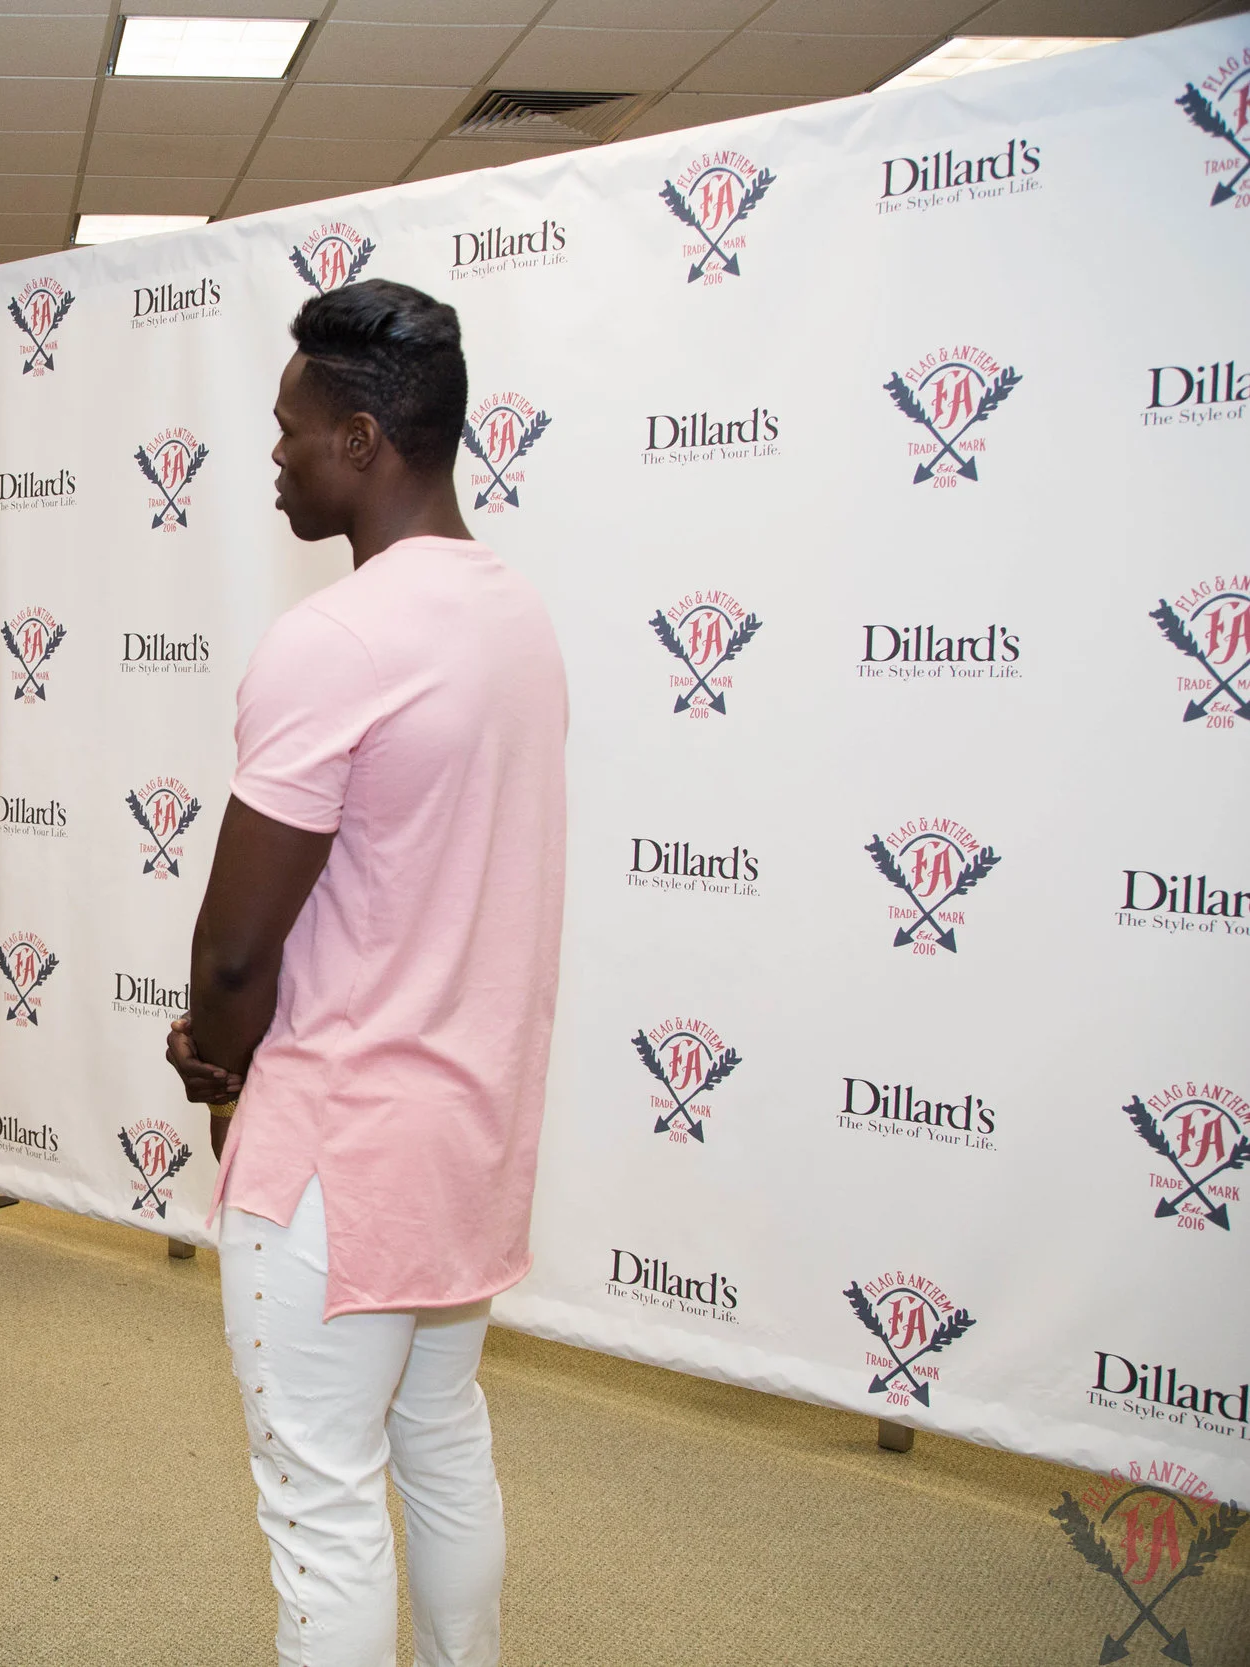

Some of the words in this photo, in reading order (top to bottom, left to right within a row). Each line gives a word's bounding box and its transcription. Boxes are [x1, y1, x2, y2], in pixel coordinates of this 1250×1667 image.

[677, 160, 702, 188] FLAG
[704, 153, 713, 167] &
[715, 150, 757, 178] ANTHEM
[880, 139, 1040, 198] Dillard's
[875, 201, 902, 214] The
[907, 193, 943, 211] Style
[947, 189, 963, 203] of
[969, 186, 1004, 200] Your
[1009, 178, 1043, 194] Life.
[302, 230, 321, 253] FLAG
[322, 224, 329, 236] &
[331, 222, 361, 246] ANTHEM
[452, 219, 565, 267] Dillard's
[681, 244, 706, 257] TRADE
[724, 237, 746, 249] MARK
[449, 269, 468, 280] The
[471, 264, 494, 278] Style
[496, 260, 508, 271] of
[511, 257, 538, 269] Your
[542, 252, 568, 265] Life.
[703, 273, 723, 285] 2016
[133, 277, 220, 316] Dillard's
[905, 354, 936, 382] FLAG
[939, 347, 949, 362] &
[952, 346, 1000, 376] ANTHEM
[469, 399, 491, 423] FLAG
[493, 393, 499, 406] &
[501, 392, 535, 418] ANTHEM
[1140, 412, 1173, 426] The
[1179, 409, 1222, 427] Style
[1227, 404, 1246, 418] of
[646, 407, 778, 450] Dillard's
[641, 453, 664, 465] The
[669, 450, 699, 466] Style
[702, 449, 716, 460] of
[720, 448, 749, 459] Your
[753, 444, 780, 456] Life.
[908, 443, 937, 456] TRADE
[959, 438, 986, 451] MARK
[933, 476, 956, 488] 2016
[668, 595, 693, 621] FLAG
[695, 591, 703, 604] &
[706, 590, 745, 620] ANTHEM
[1175, 582, 1211, 612] FLAG
[1215, 576, 1226, 591] &
[122, 633, 209, 661] Dillard's
[862, 624, 1019, 661] Dillard's
[119, 664, 136, 673] The
[139, 664, 159, 676] Style
[161, 663, 170, 672] of
[173, 664, 192, 672] Your
[194, 663, 211, 671] Life.
[669, 676, 693, 687] TRADE
[711, 676, 732, 687] MARK
[857, 665, 883, 677] The
[889, 665, 924, 681] Style
[928, 665, 944, 677] of
[950, 666, 984, 677] Your
[989, 665, 1022, 677] Life.
[690, 708, 708, 719] 2016
[886, 821, 917, 848] FLAG
[919, 817, 929, 831] &
[932, 818, 979, 852] ANTHEM
[630, 838, 758, 881] Dillard's
[626, 874, 648, 887] The
[652, 877, 681, 892] Style
[684, 880, 697, 890] of
[702, 881, 730, 893] Your
[734, 884, 760, 896] Life.
[888, 906, 917, 919] TRADE
[938, 913, 964, 925] MARK
[1115, 913, 1146, 927] The
[1152, 916, 1194, 934] Style
[1199, 920, 1218, 933] of
[913, 943, 935, 956] 2016
[115, 973, 189, 1010] Dillard
[649, 1020, 674, 1043] FLAG
[676, 1017, 684, 1030] &
[686, 1018, 724, 1052] ANTHEM
[650, 1095, 673, 1109] TRADE
[690, 1105, 711, 1118] MARK
[841, 1076, 995, 1134] Dillard's
[1148, 1085, 1183, 1112] FLAG
[1187, 1082, 1198, 1097] &
[669, 1131, 687, 1144] 2016
[837, 1115, 863, 1130] The
[868, 1120, 903, 1137] Style
[907, 1127, 922, 1138] of
[927, 1129, 961, 1144] Your
[965, 1134, 997, 1150] Life.
[1149, 1173, 1183, 1190] TRADE
[1208, 1186, 1239, 1201] MARK
[1178, 1215, 1204, 1232] 2016
[610, 1249, 736, 1310] Dillard's
[864, 1274, 893, 1297] FLAG
[896, 1272, 905, 1286] &
[908, 1274, 954, 1312] ANTHEM
[606, 1283, 627, 1298] The
[631, 1289, 659, 1306] Style
[662, 1299, 675, 1309] of
[680, 1301, 708, 1318] Your
[712, 1309, 739, 1326] Life.
[865, 1351, 892, 1368] TRADE
[913, 1366, 938, 1381] MARK
[888, 1391, 910, 1408] 2016
[1092, 1351, 1250, 1423] Dillard
[1087, 1391, 1117, 1409] The
[1123, 1399, 1164, 1420] Style
[1169, 1412, 1187, 1425] of
[1194, 1416, 1235, 1436] Your
